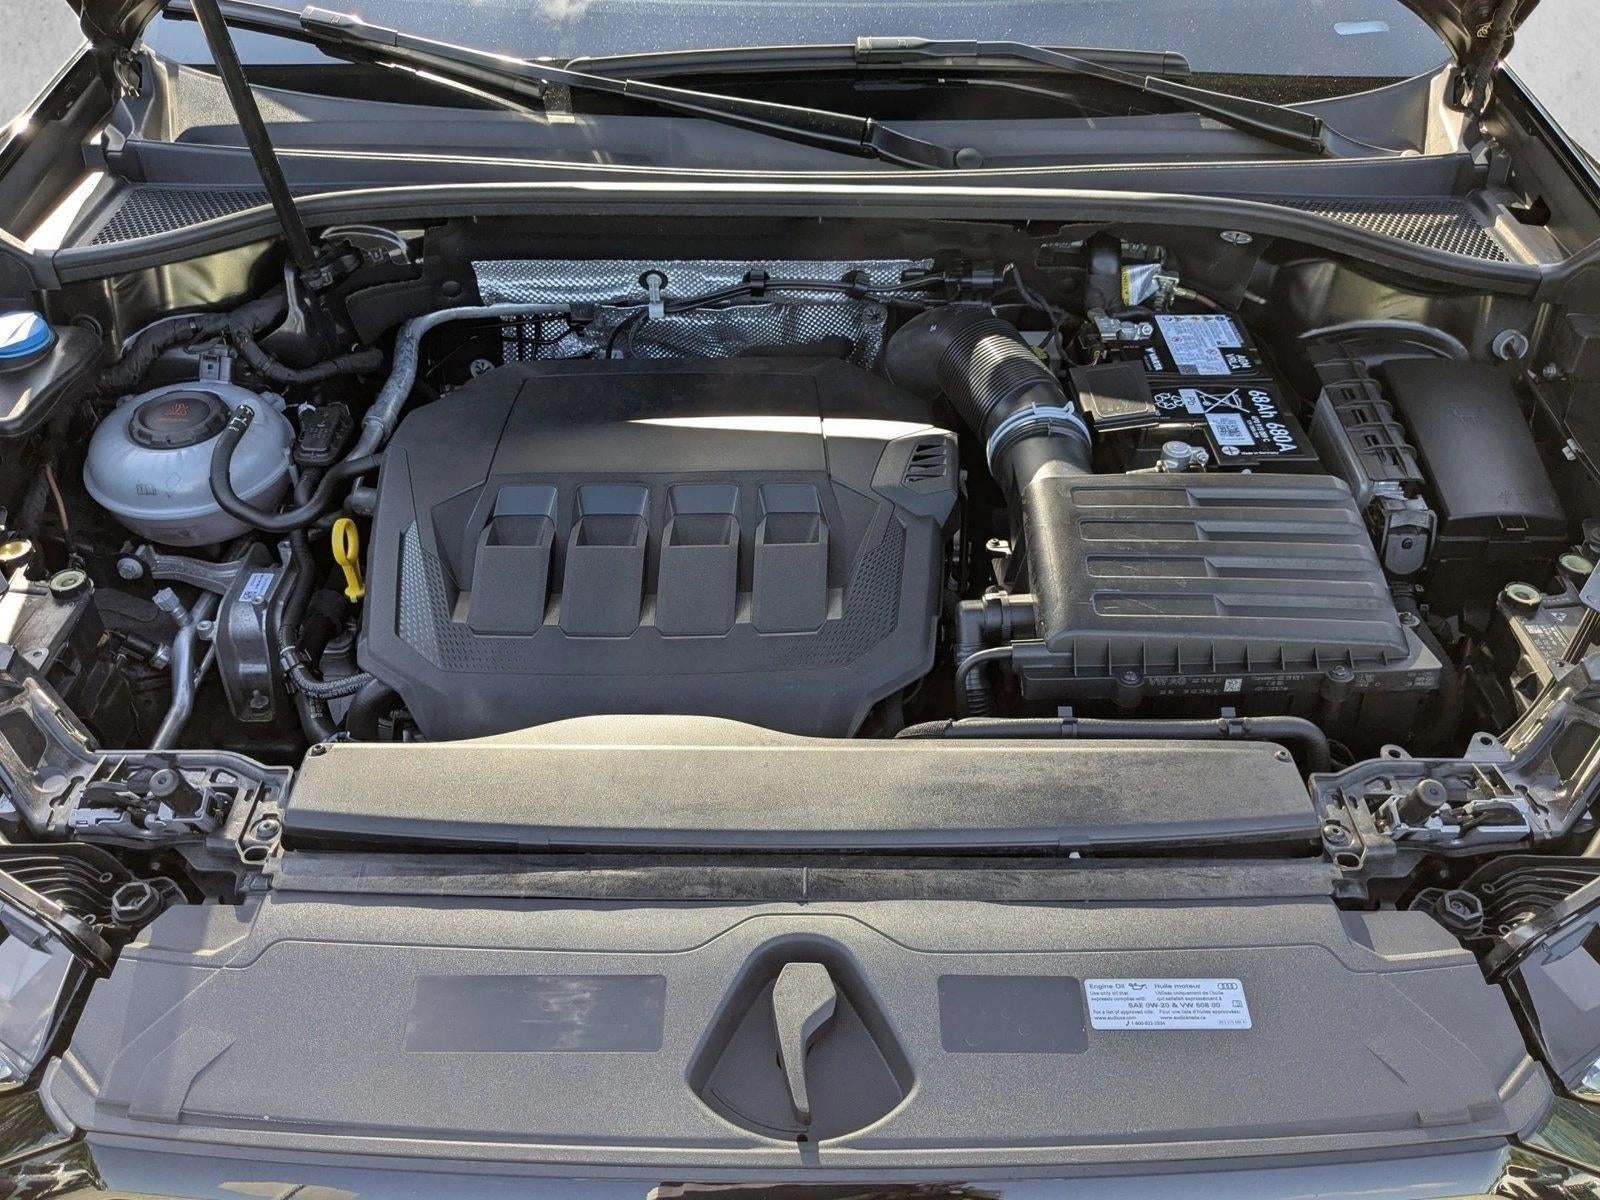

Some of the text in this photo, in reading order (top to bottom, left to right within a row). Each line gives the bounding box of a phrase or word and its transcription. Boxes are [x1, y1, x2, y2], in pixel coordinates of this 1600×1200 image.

[1225, 353, 1240, 369] VRLA
[1236, 354, 1252, 368] AGM
[1185, 396, 1196, 406] Pb
[1248, 390, 1278, 418] 68Ah
[1265, 422, 1297, 452] 680A
